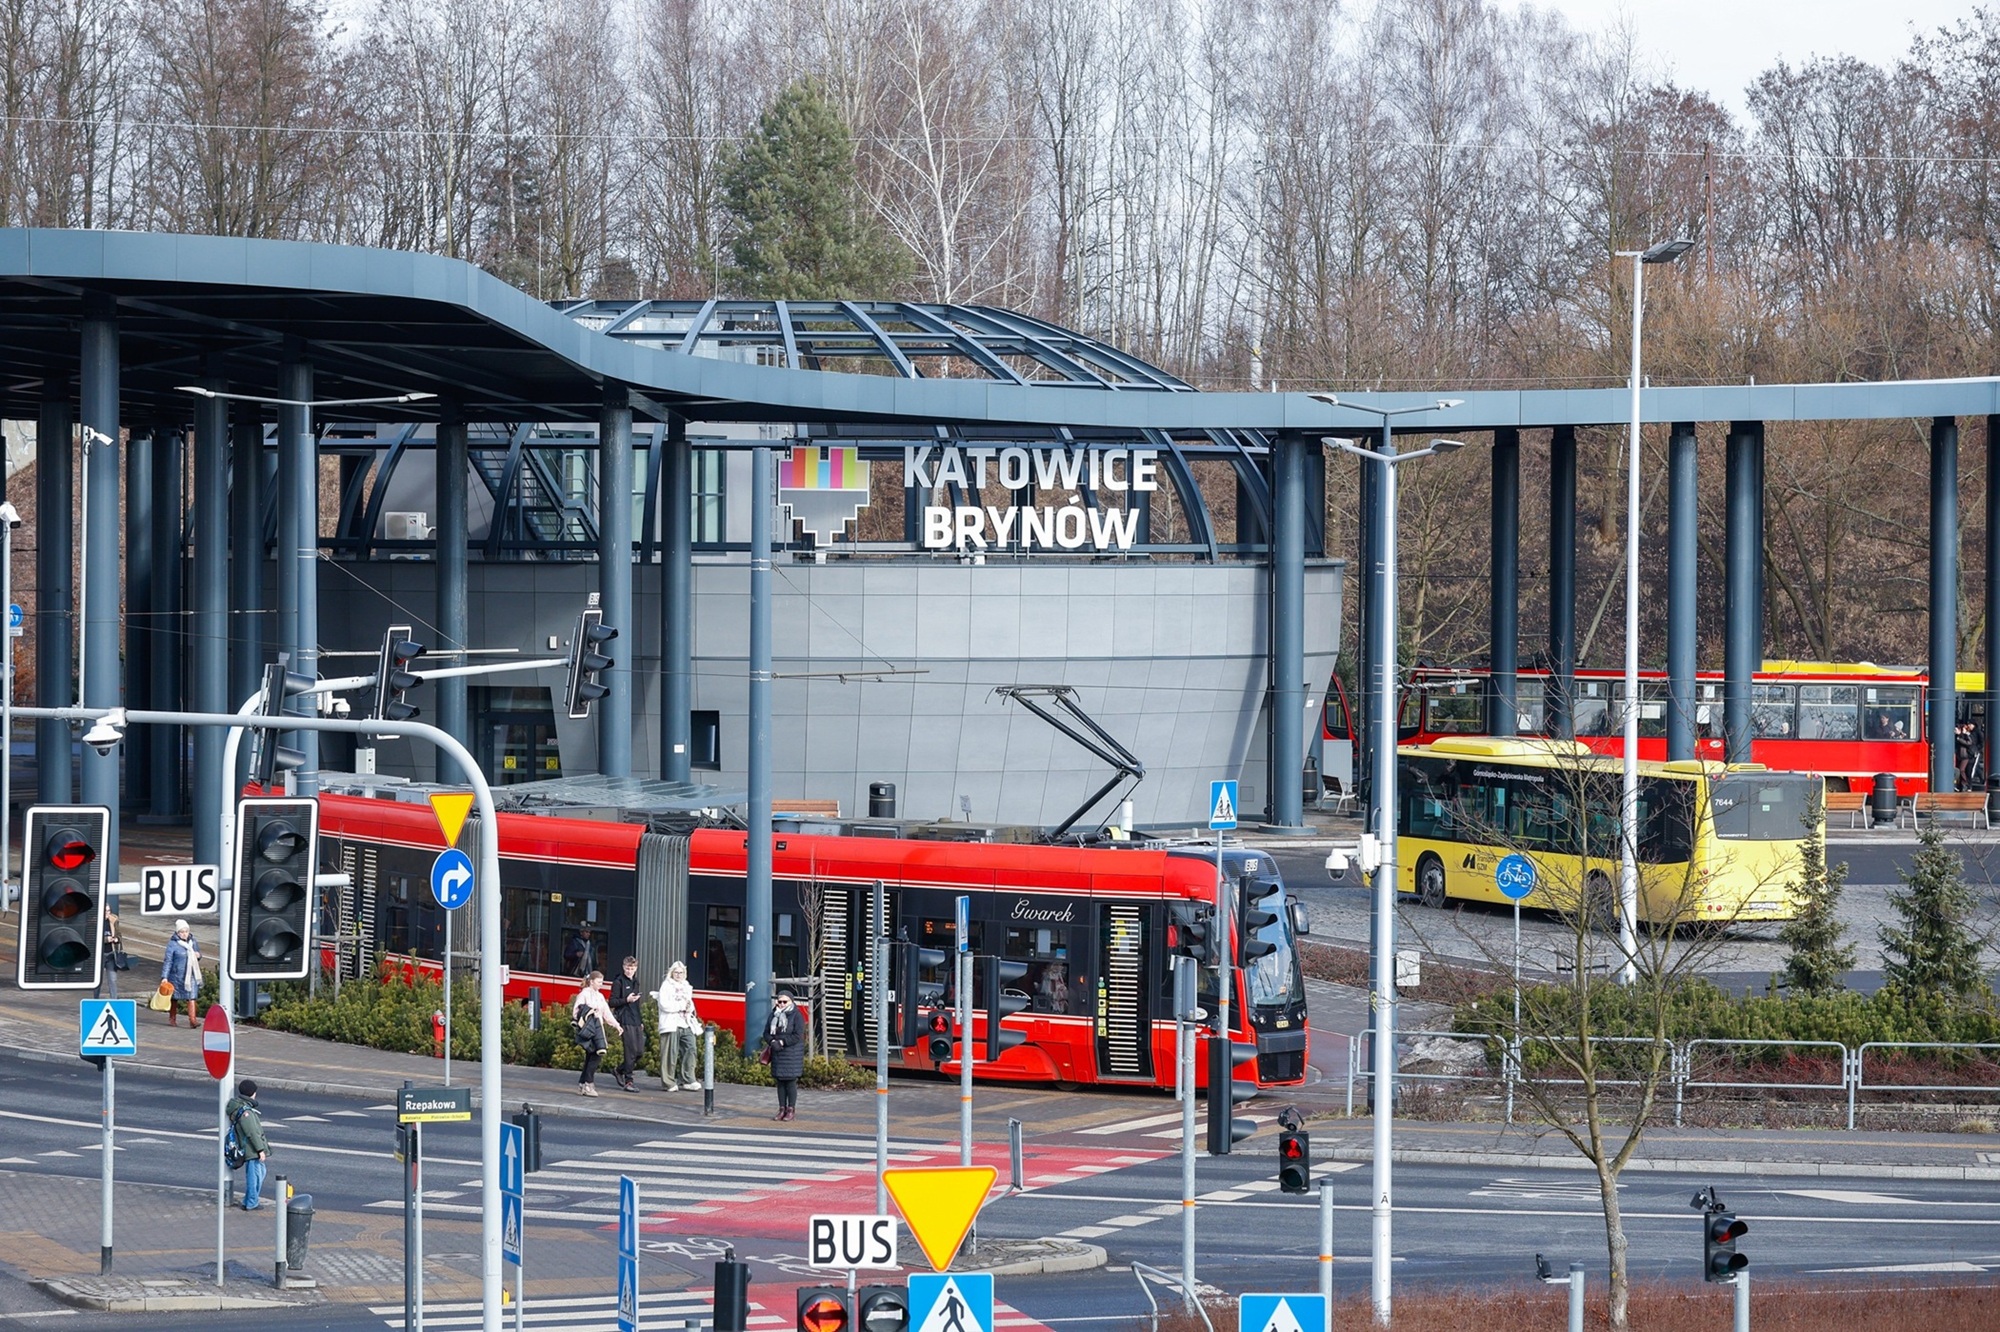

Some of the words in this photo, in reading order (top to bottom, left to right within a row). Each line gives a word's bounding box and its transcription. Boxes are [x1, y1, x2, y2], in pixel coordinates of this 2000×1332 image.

[904, 447, 1158, 491] KATOWICE
[924, 494, 1140, 550] BRYNÓW
[1714, 798, 1733, 806] 7644
[1245, 860, 1258, 871] BUS
[145, 869, 216, 911] BUS
[1011, 897, 1075, 922] Gwarek
[405, 1099, 456, 1112] Rzepakowa
[813, 1219, 892, 1264] BUS
